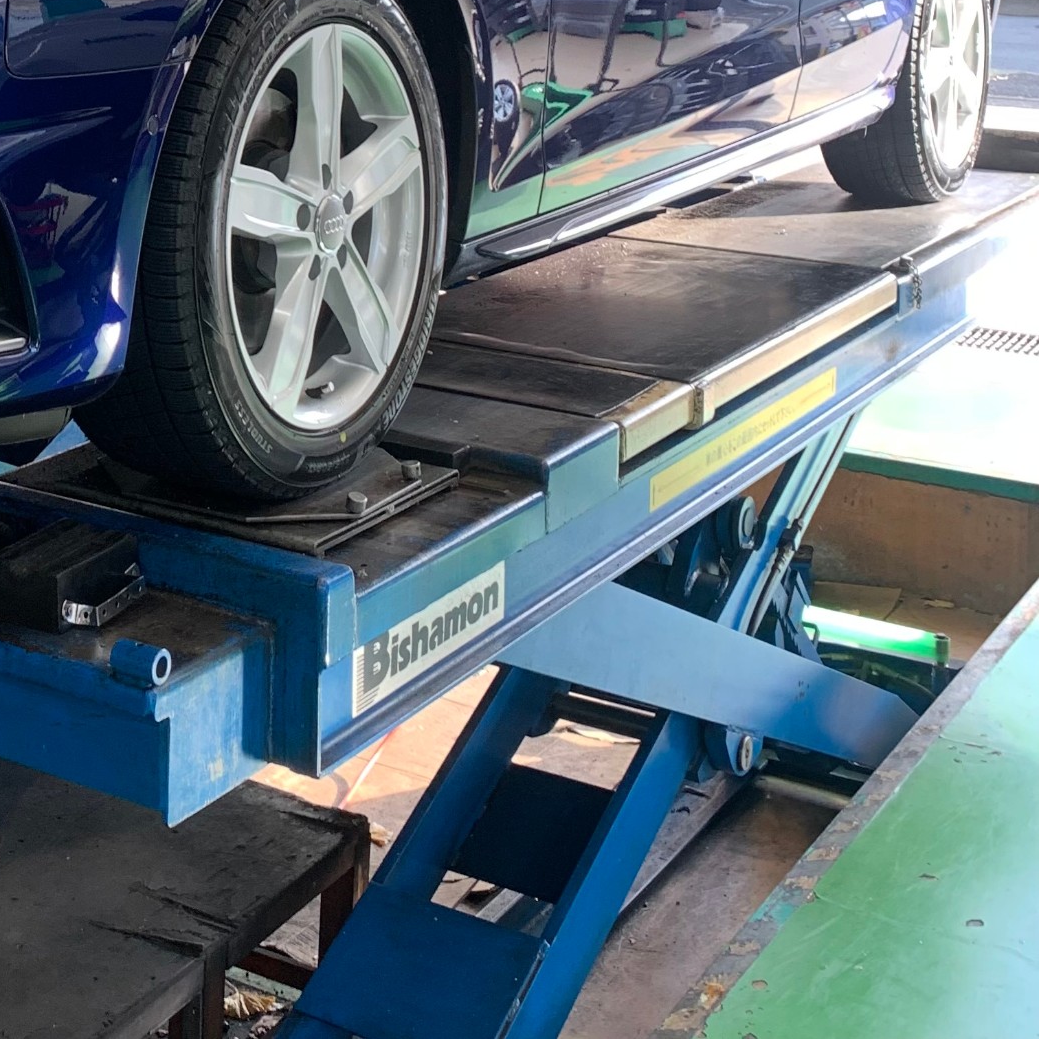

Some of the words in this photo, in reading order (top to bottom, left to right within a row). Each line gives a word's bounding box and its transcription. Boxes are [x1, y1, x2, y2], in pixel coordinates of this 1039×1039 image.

[381, 291, 438, 431] BRIDGESTONE
[234, 399, 273, 454] STUDLESS
[362, 580, 500, 697] Bishamon
